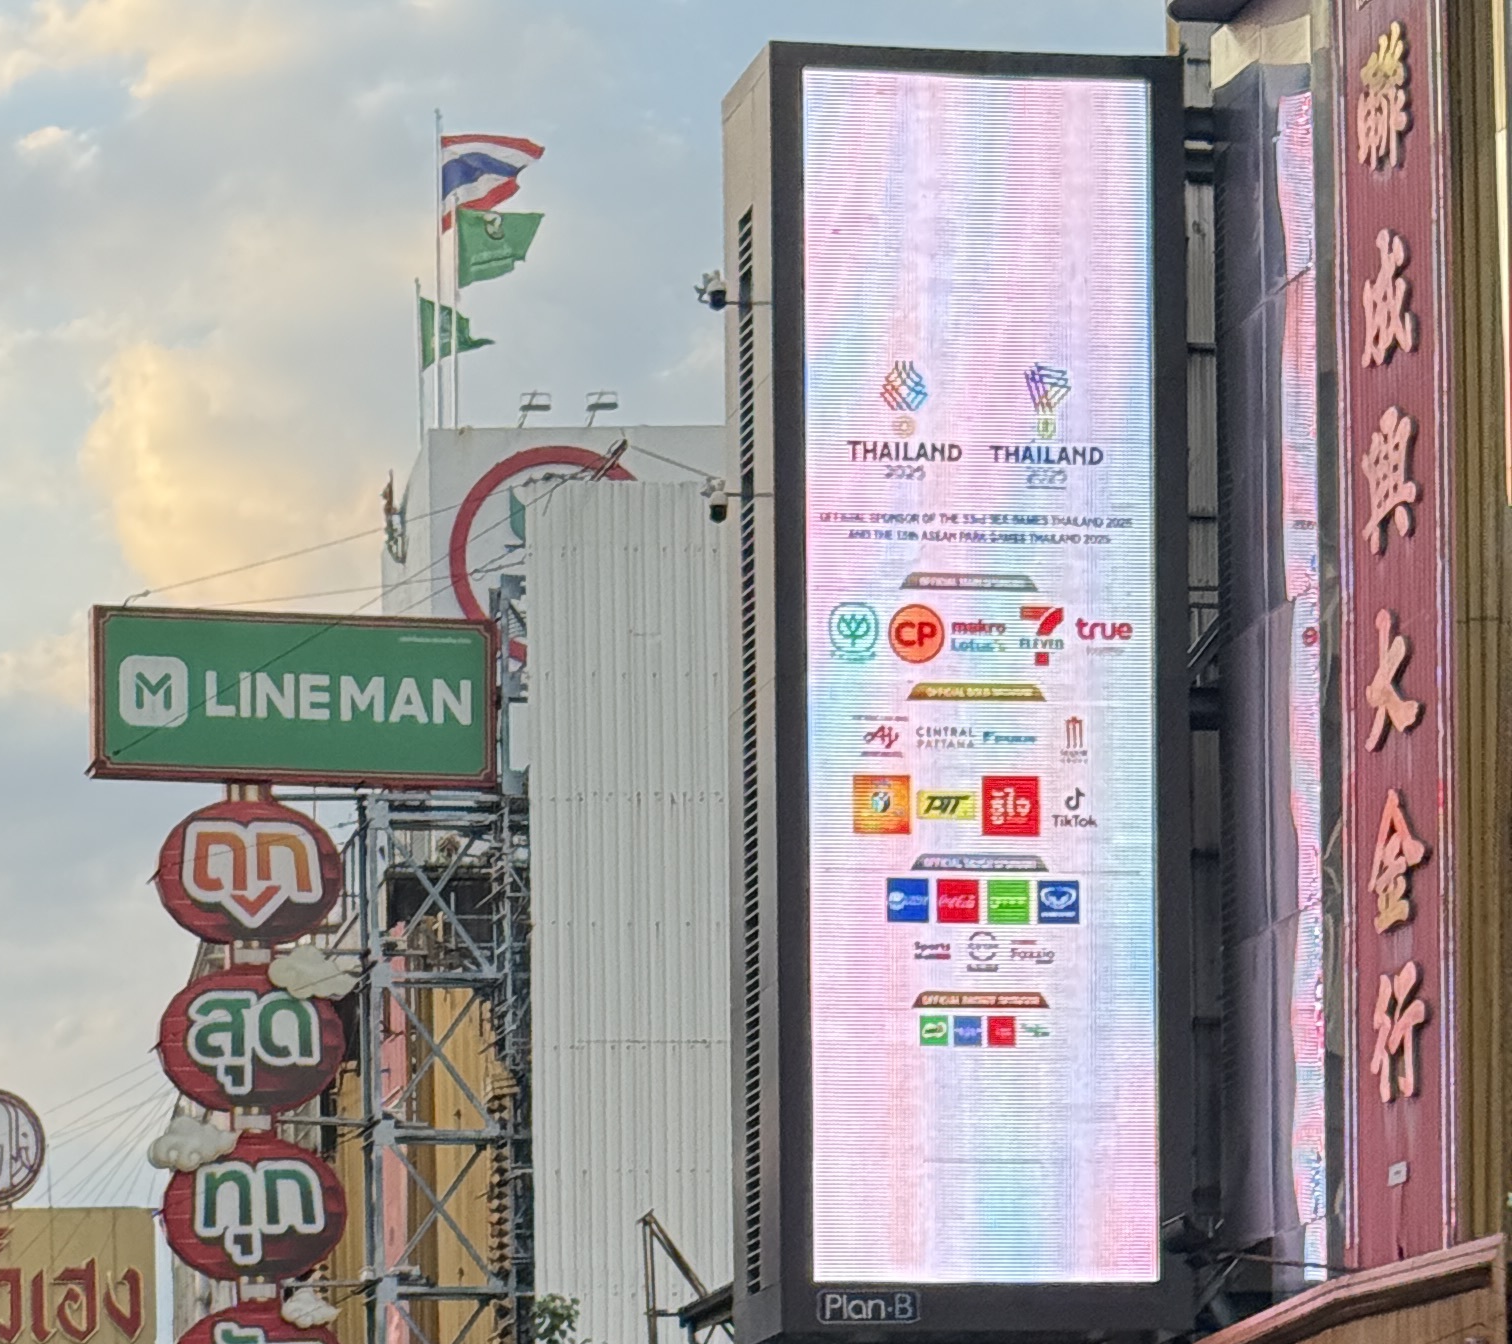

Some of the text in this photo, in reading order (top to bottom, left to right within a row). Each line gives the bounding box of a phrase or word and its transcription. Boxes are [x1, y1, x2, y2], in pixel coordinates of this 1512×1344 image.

[847, 440, 962, 462] THAILAND
[990, 445, 1103, 466] THAILAND
[895, 621, 937, 646] CP
[1075, 617, 1133, 641] true
[916, 726, 976, 738] CENTRAL
[1051, 814, 1098, 828] TikTok
[192, 996, 312, 1089] สุด
